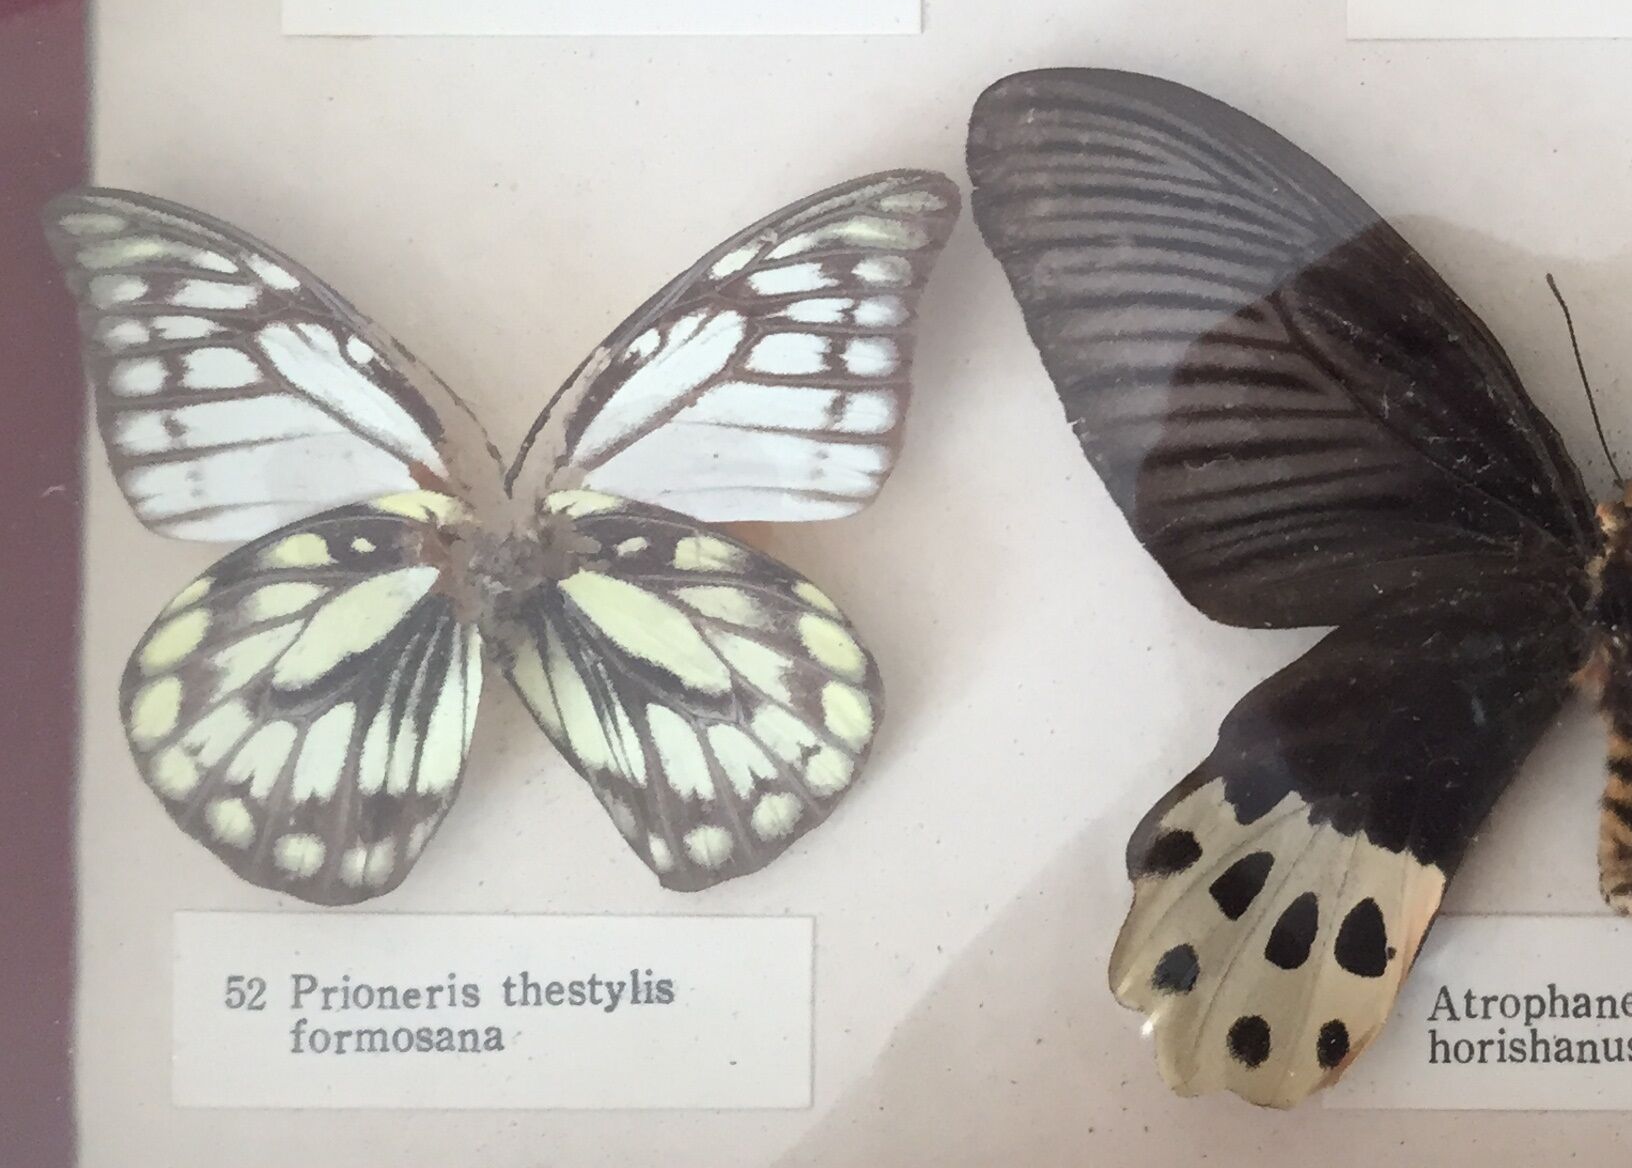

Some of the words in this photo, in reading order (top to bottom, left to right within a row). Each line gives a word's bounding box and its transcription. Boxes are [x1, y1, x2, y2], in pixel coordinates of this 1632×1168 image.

[224, 974, 267, 1011] 52
[289, 973, 481, 1011] Prioneris
[501, 968, 676, 1014] thestylis
[289, 1017, 506, 1055] formosana
